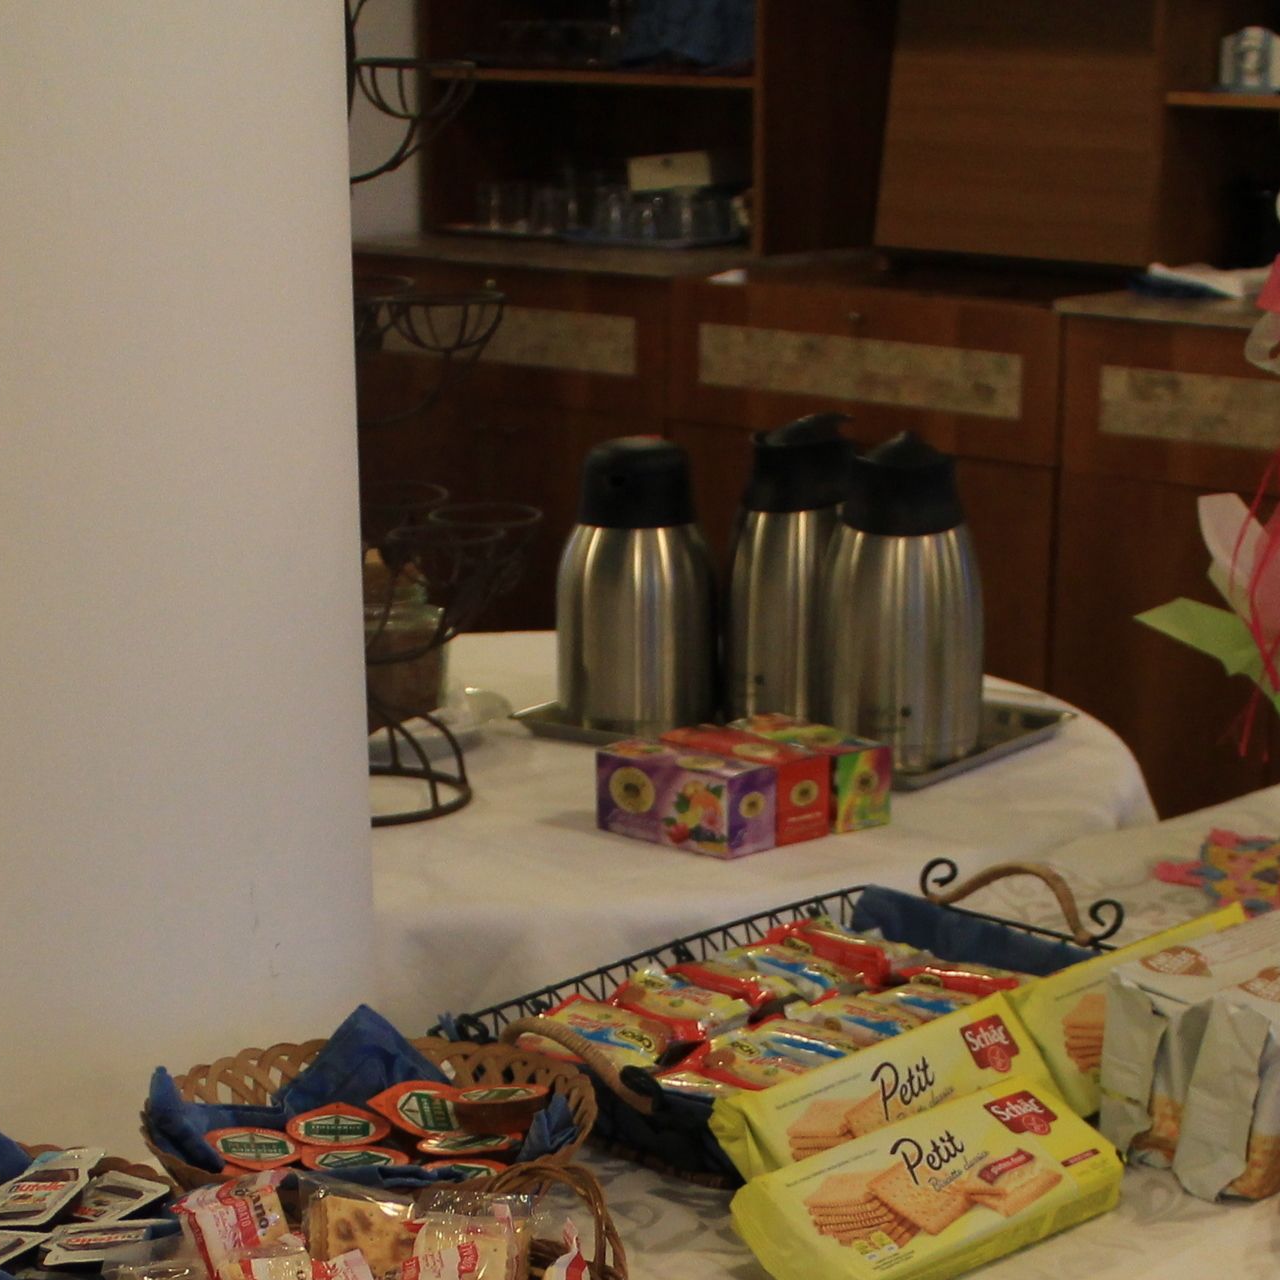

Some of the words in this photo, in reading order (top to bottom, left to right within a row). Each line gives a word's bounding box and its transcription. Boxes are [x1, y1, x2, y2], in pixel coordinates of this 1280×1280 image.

[966, 1024, 1011, 1051] Schär
[871, 1056, 936, 1121] Petit
[991, 1097, 1046, 1122] Schär
[890, 1130, 964, 1185] Petit
